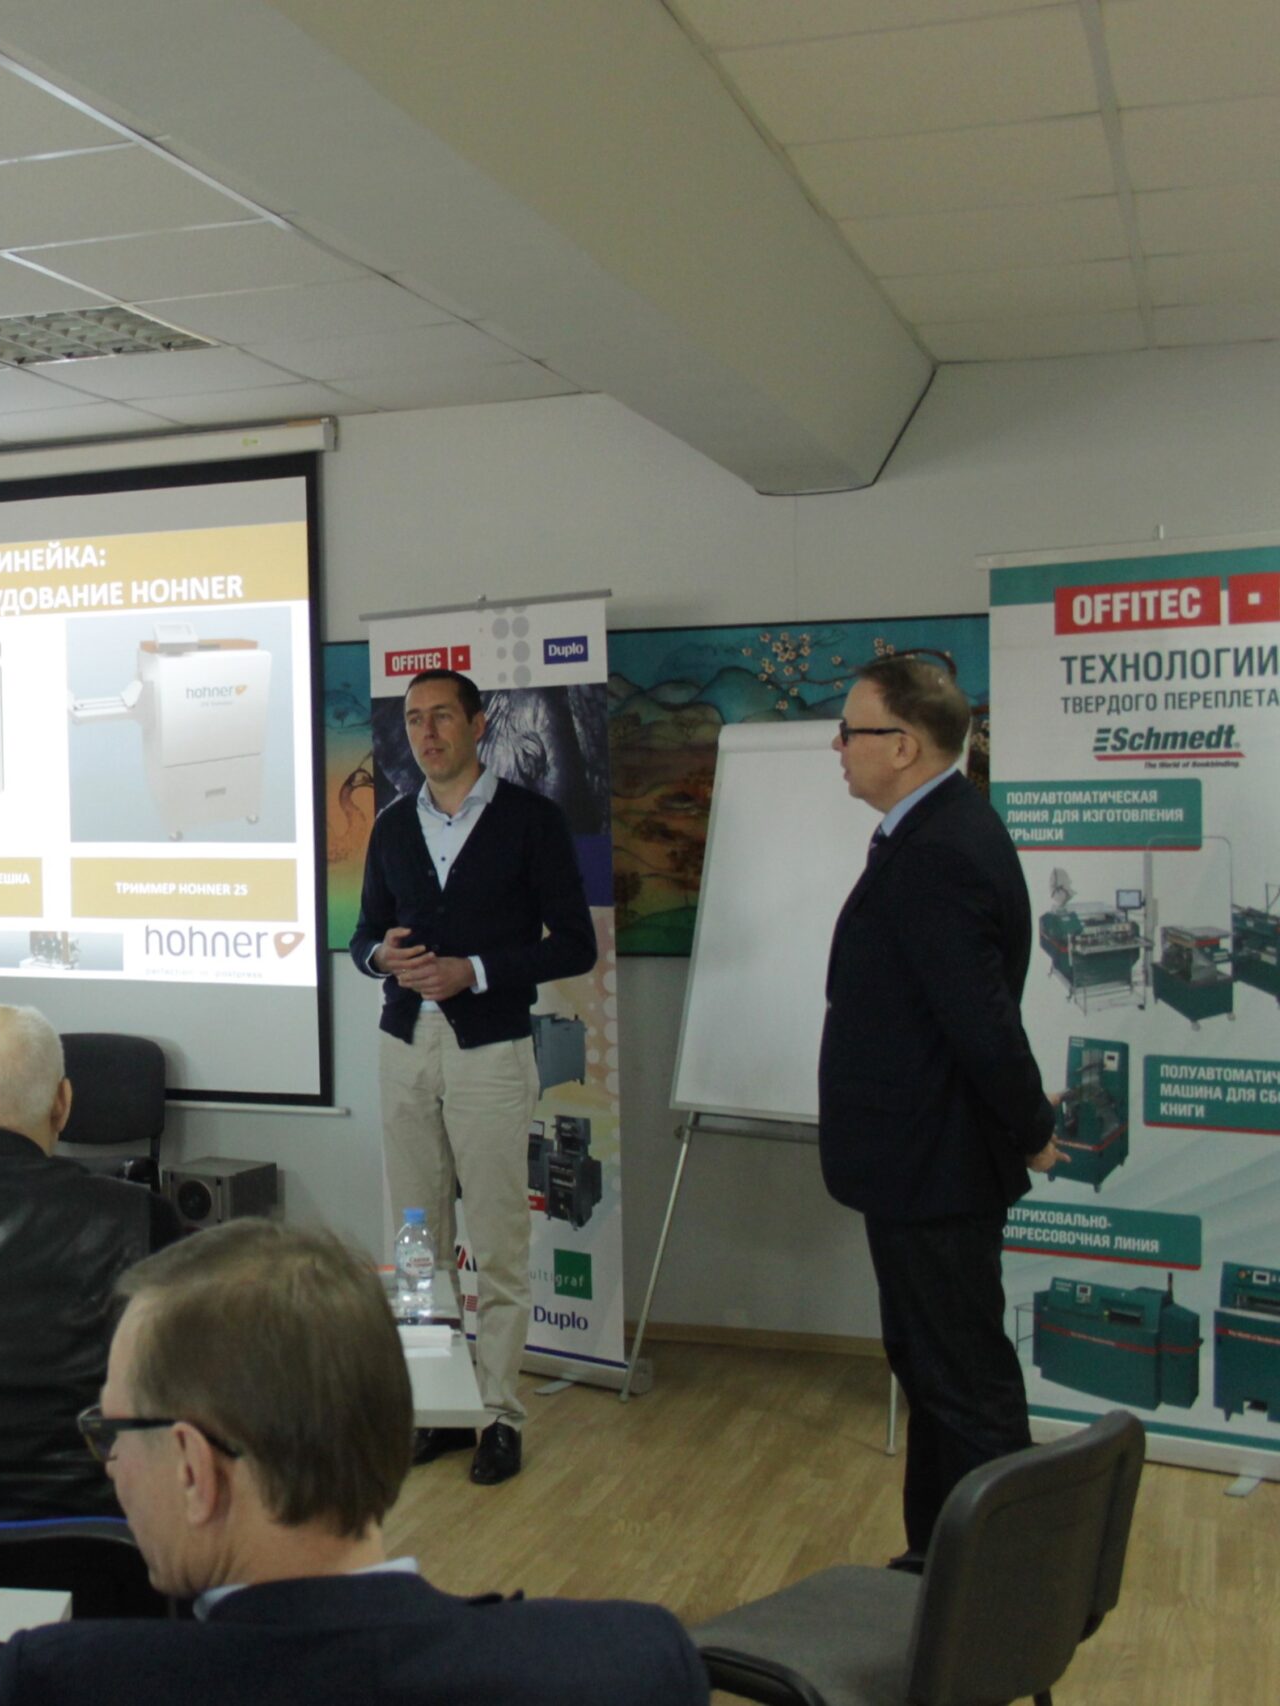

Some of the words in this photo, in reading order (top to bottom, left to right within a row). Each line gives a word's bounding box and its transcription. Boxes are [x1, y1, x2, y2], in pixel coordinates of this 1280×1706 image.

[131, 574, 243, 604] HOHNER
[1072, 587, 1202, 626] OFFITEC
[548, 641, 584, 657] Duplo
[391, 652, 441, 672] OFFITEC
[1060, 645, 1278, 685] ТЕХНОЛОГИИ
[1061, 693, 1157, 716] ТВЕРДОГО
[1164, 688, 1279, 712] ПЕРЕПЛЕТА
[1110, 724, 1236, 752] Schmedt
[1006, 790, 1158, 805] ПОЛУАВТОМАТИЧЕСКАЯ
[1007, 810, 1049, 823] ЛИНИЯ
[1052, 809, 1079, 824] ДЛЯ
[1083, 808, 1184, 823] ИЗГОТОВЛЕНИЯ
[115, 882, 176, 894] ТРИММЕР
[179, 883, 231, 895] HOHNER
[145, 924, 268, 958] hohner
[1160, 1083, 1222, 1100] МАШИНА
[1226, 1087, 1256, 1104] ДЛЯ
[1260, 1089, 1280, 1104] СБ
[1160, 1102, 1205, 1117] КНИГИ
[1002, 1225, 1110, 1248] ОПРЕССОВОЧНАЯ
[1114, 1236, 1159, 1253] ЛИНИЯ
[529, 1269, 584, 1287] ultigraf
[533, 1305, 588, 1330] Duplo
